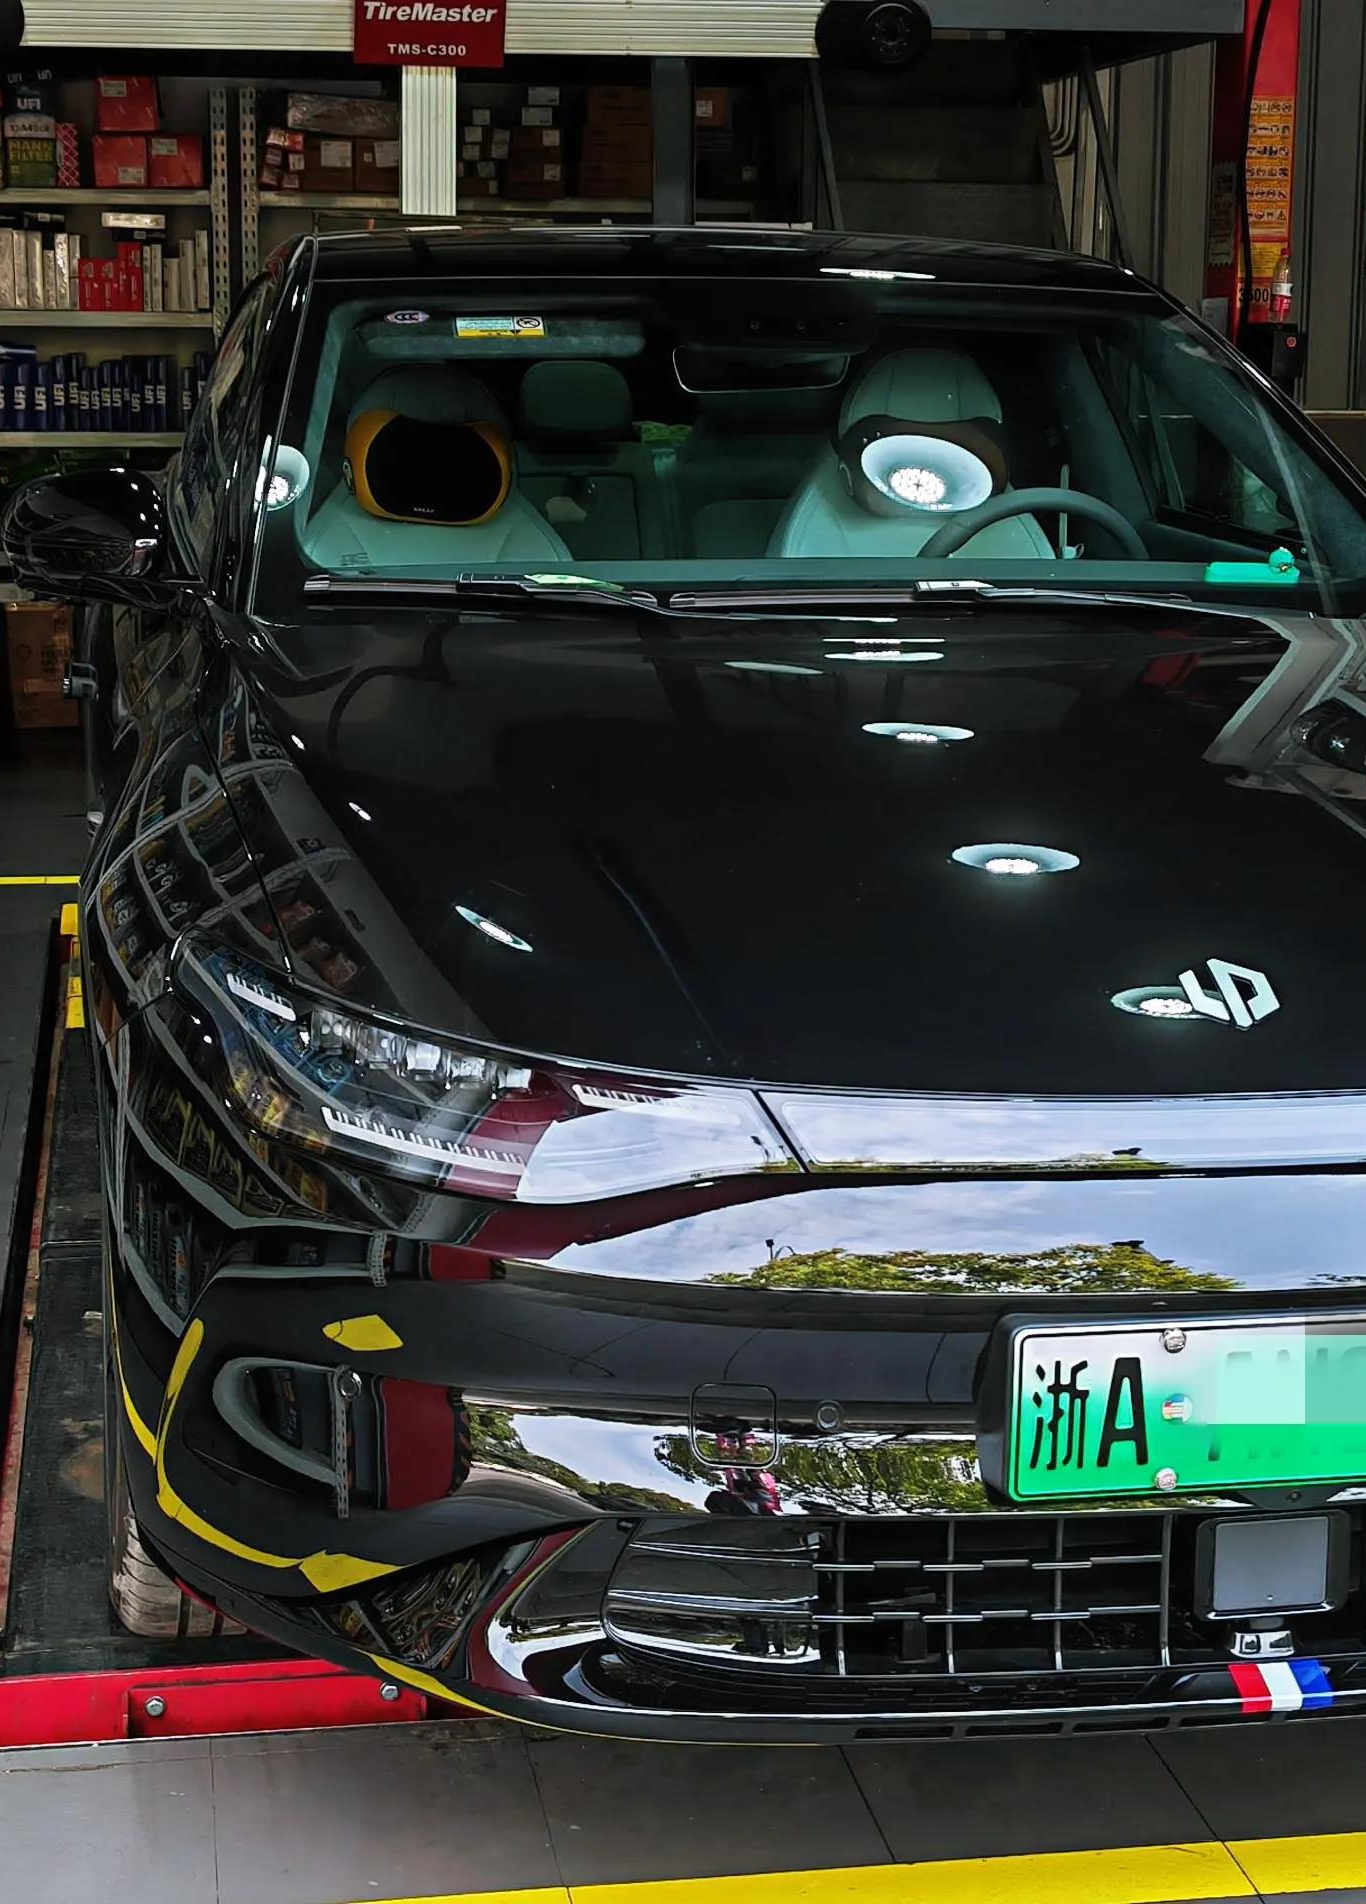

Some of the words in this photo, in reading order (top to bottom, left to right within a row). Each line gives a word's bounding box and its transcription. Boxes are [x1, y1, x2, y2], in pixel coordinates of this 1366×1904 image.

[364, 2, 498, 23] TireMaster
[387, 43, 466, 56] TMS-C300
[17, 97, 41, 110] UFI
[14, 385, 26, 410] UFI
[35, 386, 47, 411] UFI
[53, 383, 65, 406] UFI
[80, 391, 89, 410] UFI
[101, 387, 111, 407] UFI
[112, 388, 122, 407] UFI
[144, 385, 154, 404] UFI
[156, 385, 166, 405] UFI
[1028, 1355, 1150, 1472] 浙A
